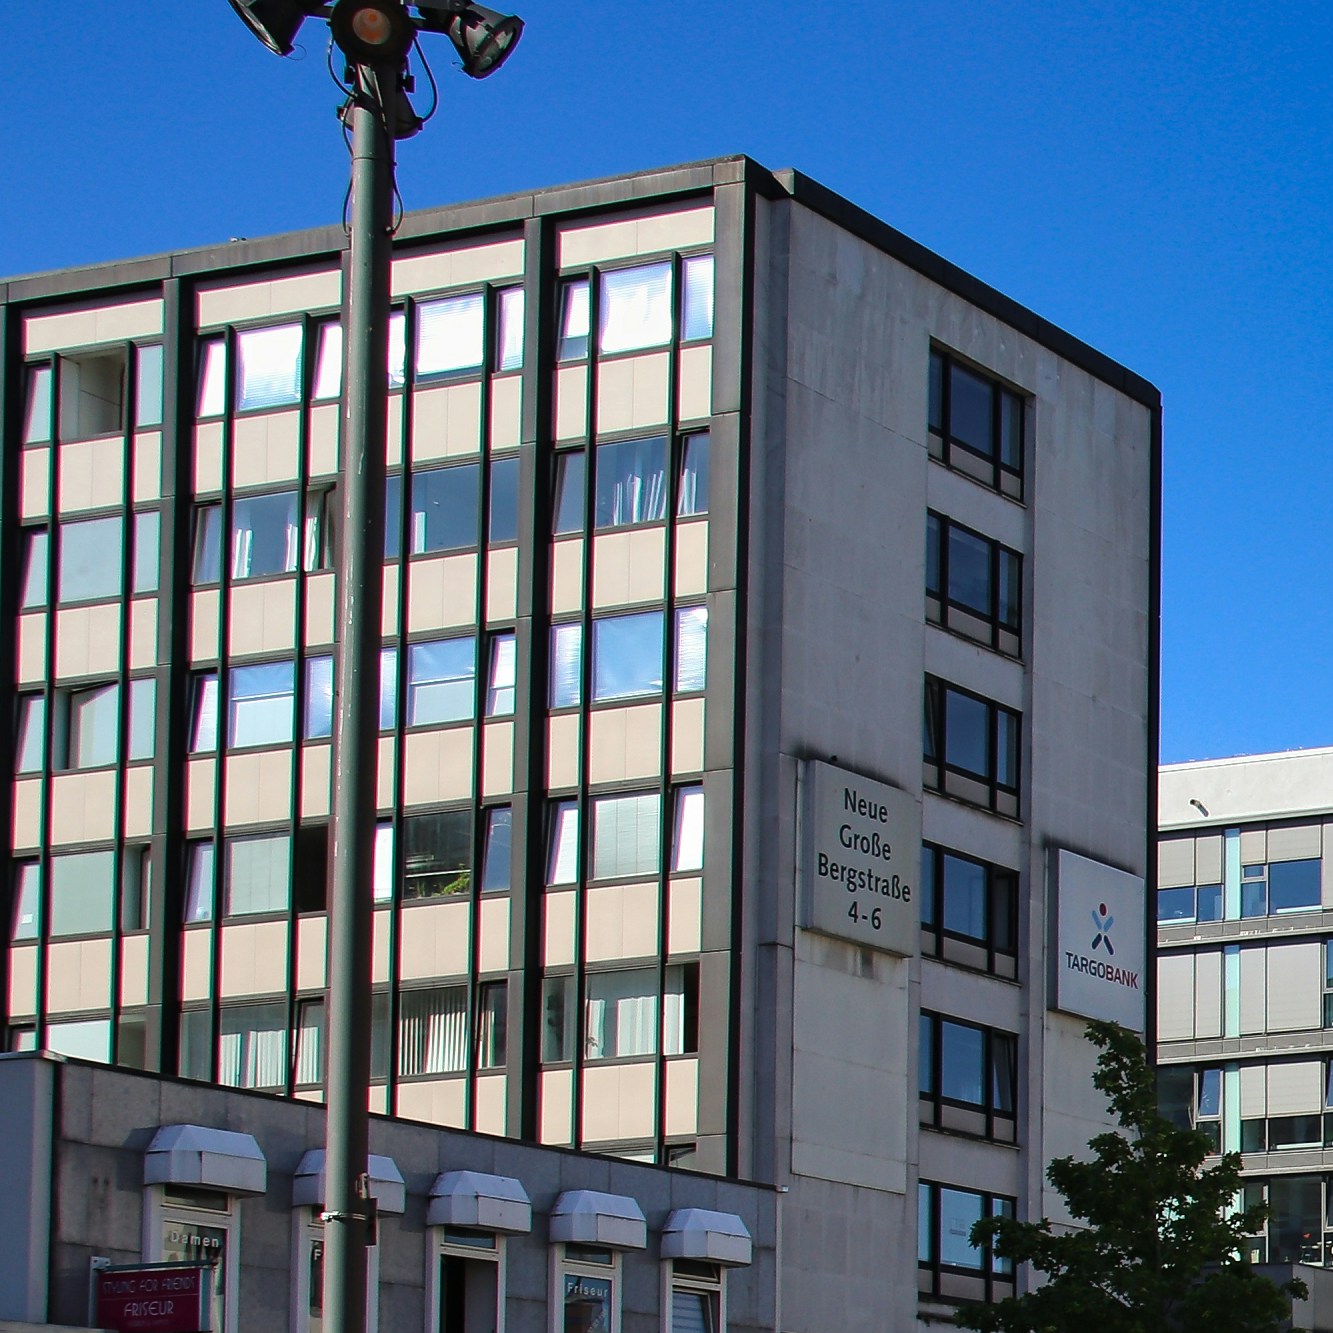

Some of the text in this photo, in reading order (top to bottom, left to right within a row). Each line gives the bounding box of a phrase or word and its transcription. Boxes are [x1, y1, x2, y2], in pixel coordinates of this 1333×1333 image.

[844, 788, 888, 823] Neue
[840, 824, 891, 861] Große
[818, 852, 911, 902] Bergstraße
[1065, 952, 1139, 989] TARGOBANK
[170, 1231, 220, 1248] Damen
[567, 1282, 608, 1297] Friseur
[124, 1300, 174, 1317] FRISEUR
